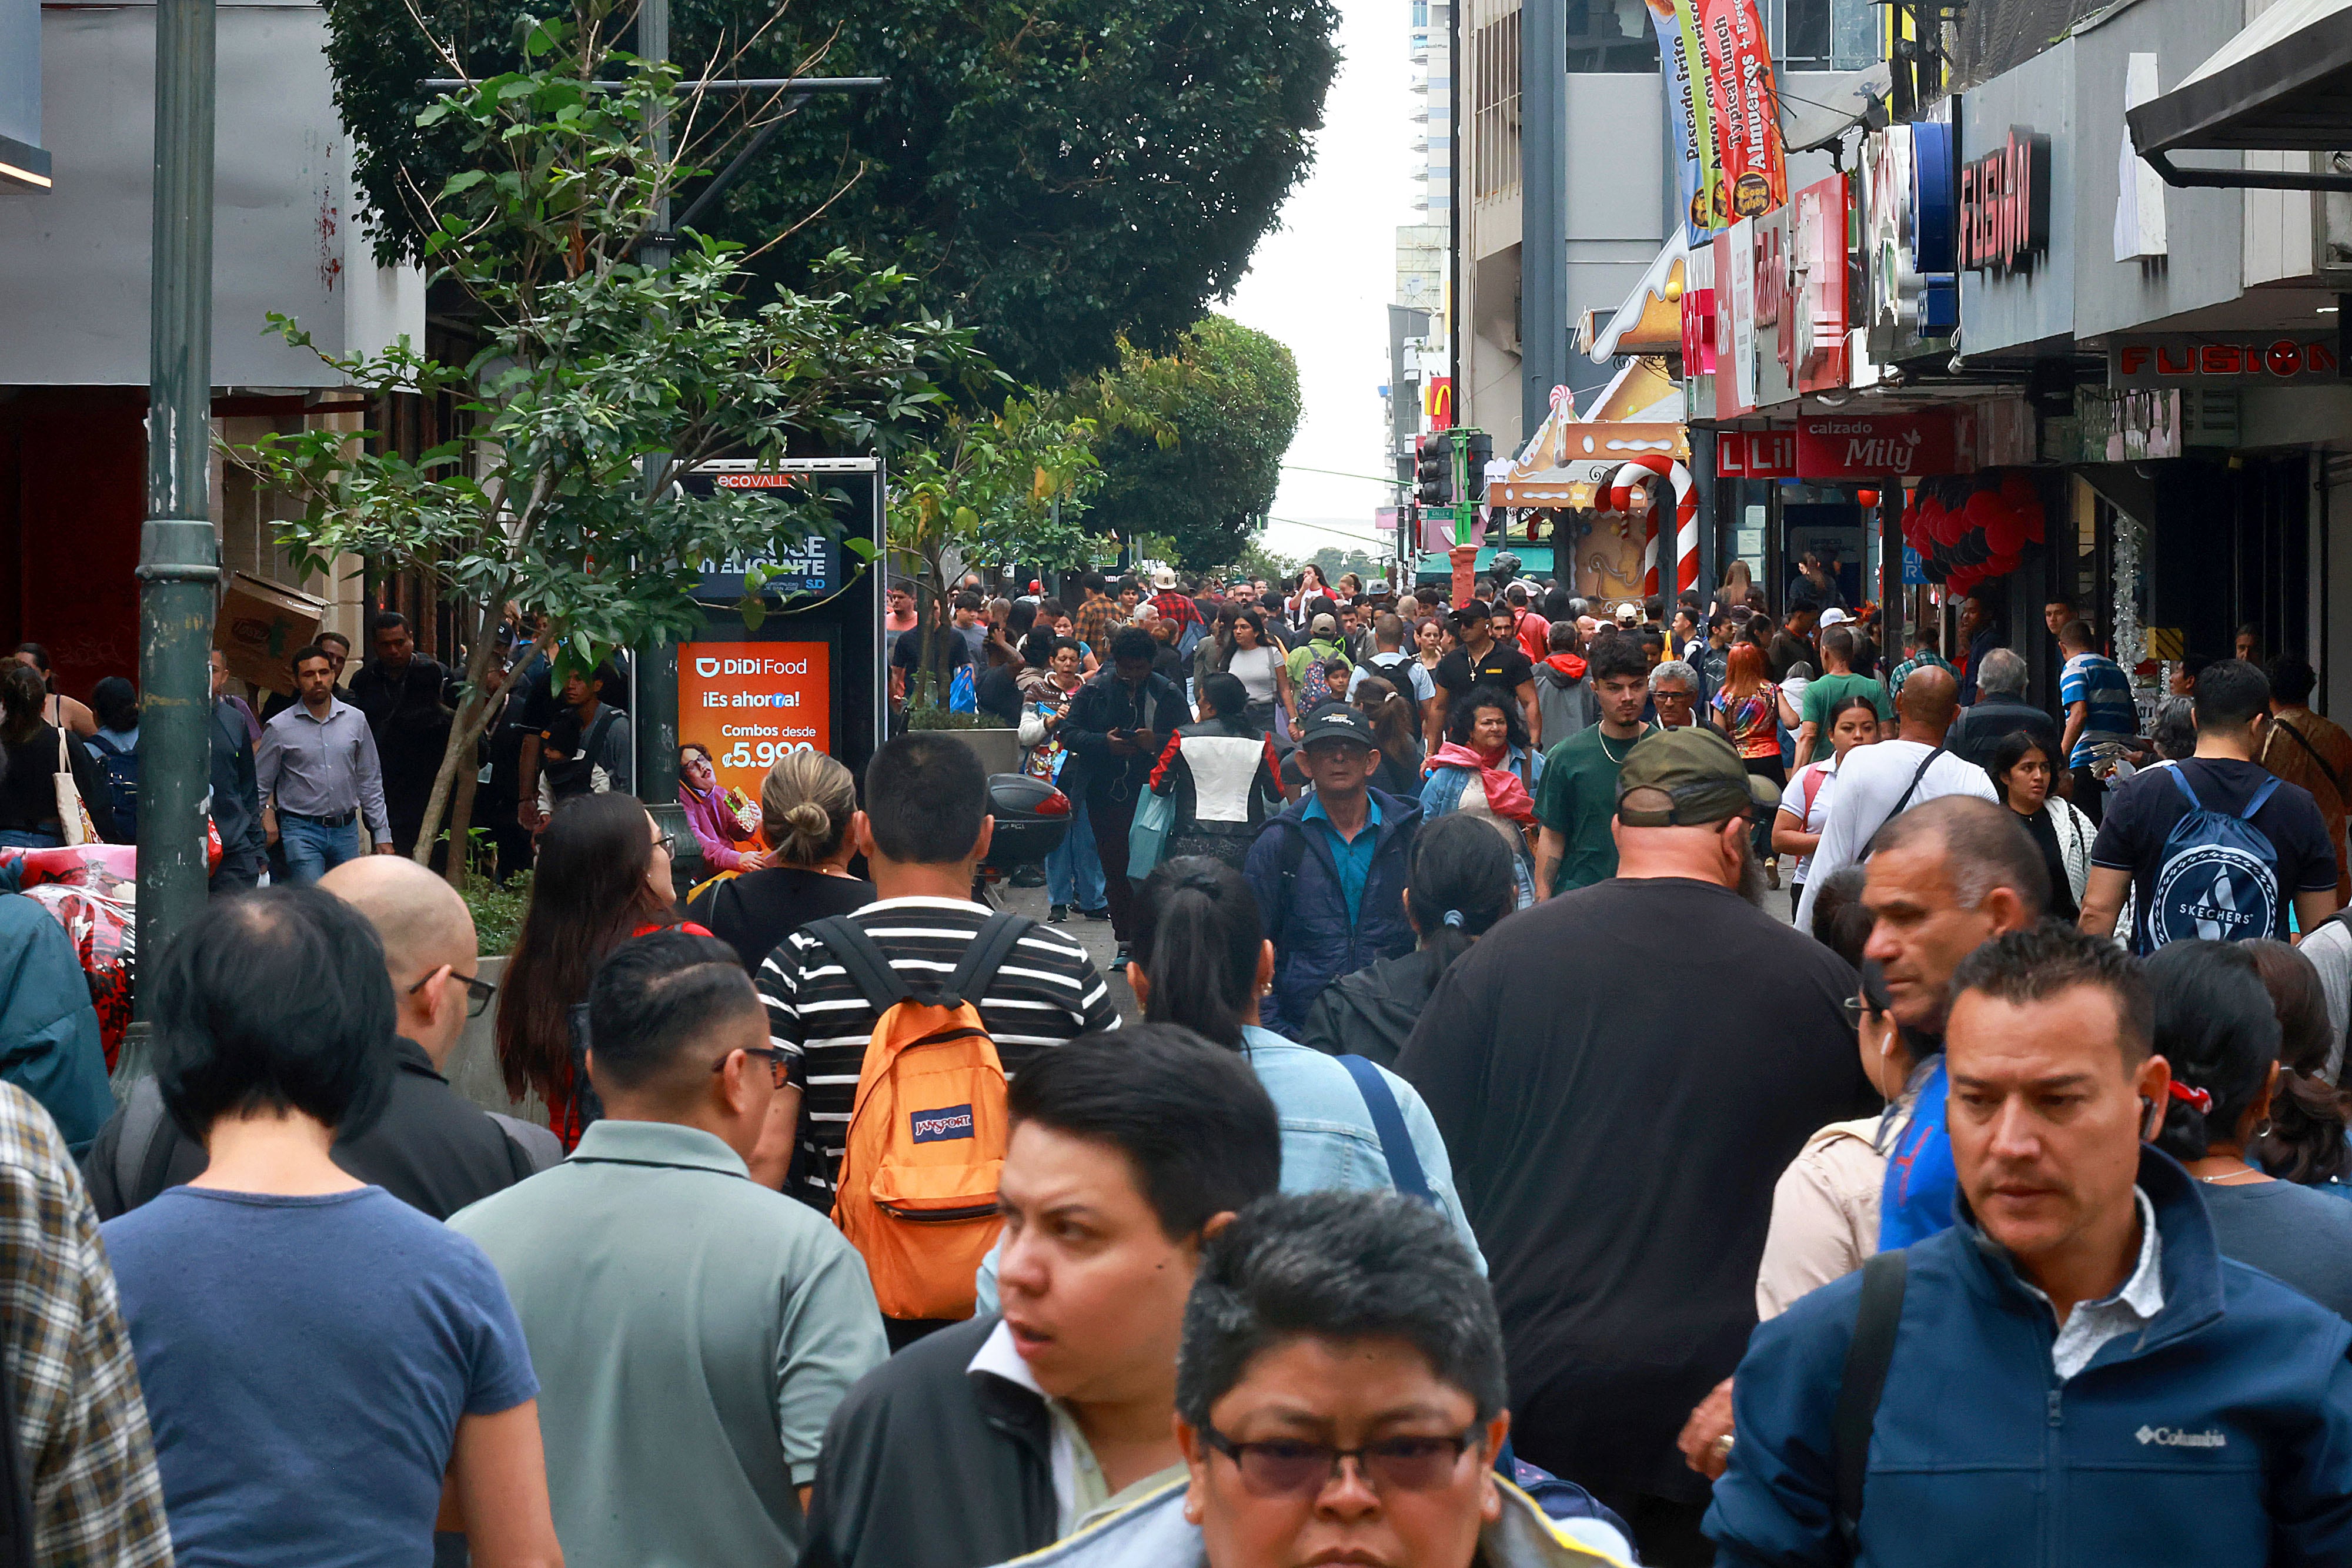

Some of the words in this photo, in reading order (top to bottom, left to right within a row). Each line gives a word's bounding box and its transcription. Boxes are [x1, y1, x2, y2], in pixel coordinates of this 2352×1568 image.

[1689, 0, 1710, 70] marisc
[1712, 14, 1735, 76] Lunch
[1739, 38, 1751, 49] +
[1673, 36, 1690, 82] frito
[1704, 75, 1715, 109] con
[1681, 85, 1699, 162] Pescado
[1721, 76, 1744, 149] Typical
[1742, 54, 1766, 169] Almuerzos
[1709, 115, 1722, 169] Arroz
[1736, 184, 1767, 199] Good
[2121, 339, 2338, 377] FUSION
[1809, 421, 1873, 434] calzado
[1843, 439, 1915, 473] Mily
[718, 475, 808, 487] ecoVALL
[724, 658, 761, 674] DiDi
[764, 658, 807, 674] Food
[703, 691, 728, 707] ¡Es
[731, 691, 800, 707] ahorra!
[721, 724, 779, 737] Combos
[781, 726, 816, 737] desde
[2180, 904, 2250, 924] SKECHERS
[916, 1115, 970, 1136] JANSPORT
[2154, 1427, 2226, 1447] Columbia
